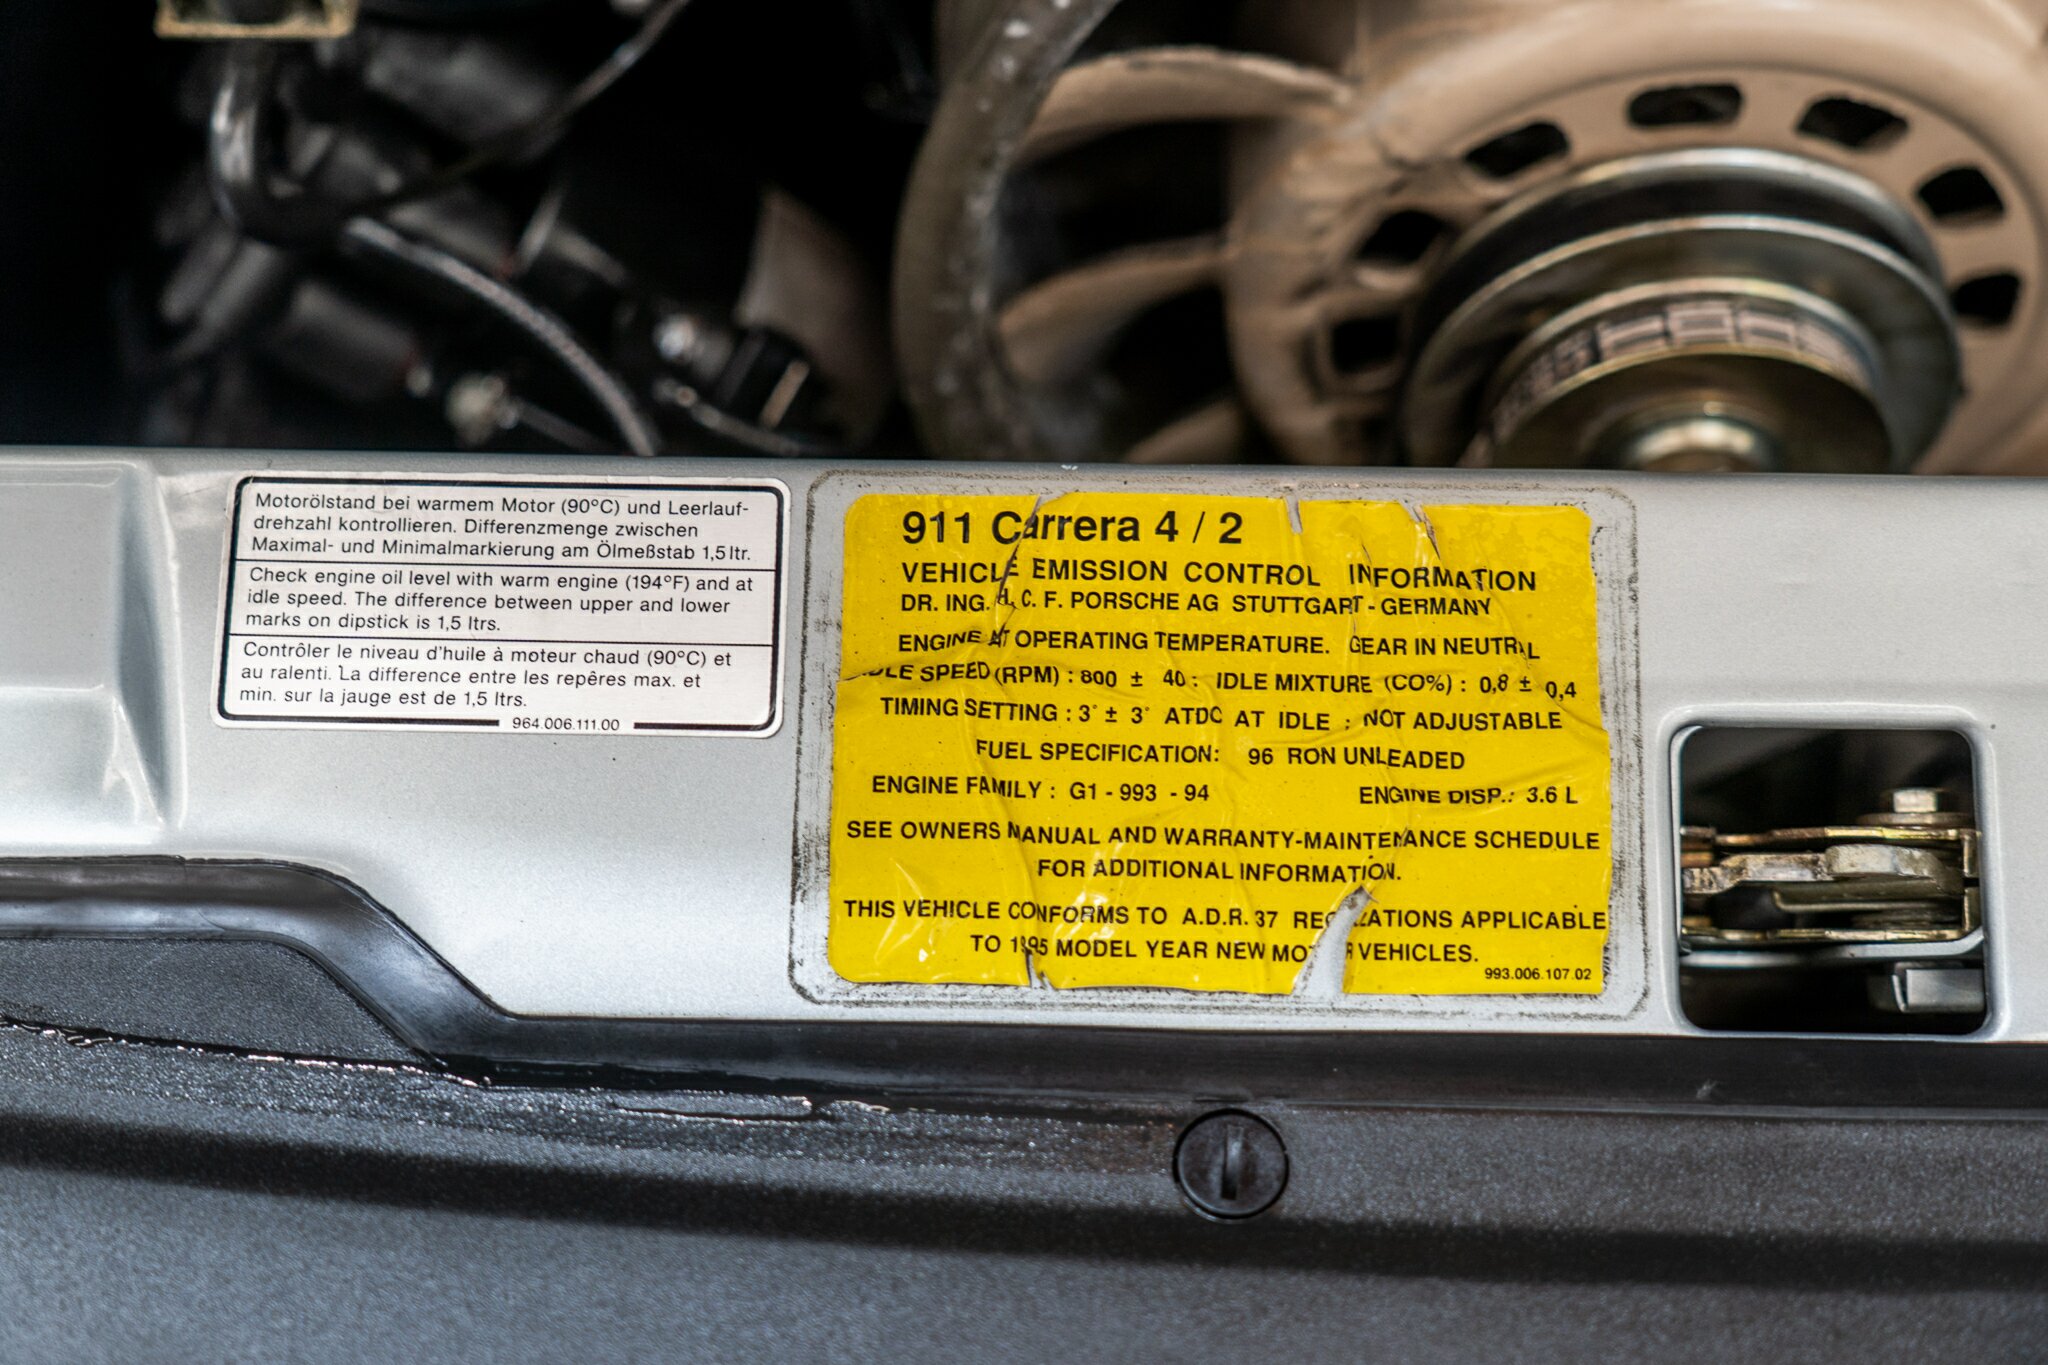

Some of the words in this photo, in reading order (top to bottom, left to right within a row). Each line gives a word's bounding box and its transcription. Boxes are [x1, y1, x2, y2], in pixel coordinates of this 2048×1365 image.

[256, 492, 376, 510] Motorölstand
[383, 495, 410, 511] bei
[417, 499, 494, 512] warmem
[501, 497, 556, 513] Motor
[627, 500, 661, 515] und
[668, 500, 749, 517] Leerlauf-
[253, 515, 332, 531] drehzahl
[338, 516, 458, 533] kontrollieren.
[464, 518, 608, 539] Differenzmenge
[615, 522, 698, 538] zwischen
[902, 510, 970, 545] 911
[991, 510, 1140, 545] Carrera
[1154, 510, 1179, 543] 4
[1218, 511, 1243, 545] 2
[252, 536, 334, 553] Maximal-
[341, 539, 375, 554] und
[382, 539, 555, 561] Minimalmarkierung
[561, 545, 589, 558] am
[596, 539, 695, 560] Ölmeßstab
[703, 545, 726, 561] 1,5
[729, 545, 752, 561] ltr.
[250, 566, 307, 583] Check
[314, 571, 376, 587] engine
[381, 570, 403, 585] oil
[409, 570, 451, 586] level
[456, 571, 493, 587] with
[500, 575, 550, 588] warm
[557, 576, 618, 592] engine
[695, 575, 729, 591] and
[735, 577, 753, 592] at
[901, 556, 1020, 584] VEHICLE
[1032, 557, 1168, 582] EMISSION
[1183, 561, 1321, 587] CONTROL
[1348, 563, 1536, 592] INFORMATION
[247, 589, 280, 604] idle
[287, 591, 348, 608] speed.
[354, 591, 388, 607] The
[394, 592, 487, 609] difference
[494, 594, 572, 610] between
[580, 599, 634, 615] upper
[639, 597, 674, 613] and
[680, 597, 731, 613] lower
[901, 593, 938, 612] DR.
[946, 593, 990, 613] ING.
[1021, 588, 1037, 608] C.
[1044, 590, 1063, 609] F.
[1070, 591, 1180, 611] PORSCHE
[1186, 593, 1219, 612] AG
[1232, 594, 1364, 615] STUTTGART
[1380, 597, 1491, 616] GERMANY
[246, 612, 301, 627] marks
[308, 615, 331, 628] on
[338, 613, 409, 632] dipstick
[416, 618, 430, 630] is
[438, 615, 462, 632] 1,5
[468, 615, 501, 631] ltrs.
[243, 641, 331, 658] Contrôler
[337, 643, 353, 659] le
[360, 647, 419, 660] niveau
[426, 645, 486, 662] d'huile
[493, 646, 503, 662] à
[511, 648, 577, 663] moteur
[583, 649, 640, 665] chaud
[713, 652, 732, 667] et
[898, 629, 982, 652] ENGINE
[987, 628, 1011, 648] AT
[1014, 629, 1149, 650] OPERATING
[1153, 631, 1330, 655] TEMPERATURE.
[1349, 634, 1408, 656] GEAR
[1414, 637, 1436, 656] IN
[241, 667, 263, 679] au
[270, 665, 333, 681] ralenti.
[338, 664, 361, 681] La
[368, 667, 461, 683] difference
[468, 670, 517, 685] entre
[524, 669, 549, 685] les
[556, 670, 626, 689] repêres
[634, 675, 677, 688] max.
[683, 674, 701, 688] et
[919, 661, 991, 683] SPEED
[993, 665, 1060, 687] (RPM)
[1080, 669, 1118, 688] 800
[1162, 669, 1186, 688] 40
[1216, 671, 1268, 691] IDLE
[1275, 673, 1373, 694] MIXTURE
[1383, 673, 1453, 696] (CO%)
[1479, 673, 1509, 694] 0,8
[1544, 680, 1577, 702] 0,4
[240, 689, 277, 701] min.
[284, 690, 313, 702] sur
[319, 688, 334, 703] la
[340, 692, 391, 707] jauge
[398, 691, 426, 705] est
[433, 690, 456, 706] de
[464, 691, 488, 707] 1,5
[495, 691, 527, 707] ltrs.
[512, 716, 620, 731] 964.006.111.00
[879, 696, 959, 717] TIMING
[963, 697, 1058, 722] SETTING
[1164, 705, 1223, 725] ATDC
[1234, 710, 1265, 728] AT
[1278, 711, 1330, 731] IDLE
[1362, 708, 1406, 730] NOT
[1412, 711, 1563, 732] ADJUSTABLE
[976, 738, 1033, 760] FUEL
[1248, 747, 1274, 766] 96
[1287, 746, 1336, 766] RON
[1343, 746, 1465, 770] UNLEADED
[872, 775, 959, 795] ENGINE
[966, 775, 1042, 799] FAMILY
[1069, 781, 1096, 801] G1
[1119, 783, 1157, 802] 993
[1184, 783, 1210, 802] 94
[1359, 785, 1441, 805] ENGINE
[1526, 785, 1558, 804] 3.6
[1565, 786, 1578, 805] L
[847, 820, 893, 839] SEE
[900, 820, 1001, 840] OWNERS
[1007, 820, 1101, 845] MANUAL
[1108, 825, 1157, 844] AND
[1164, 827, 1467, 850] WARRANTY-MAINTENANCE
[1474, 830, 1600, 850] SCHEDULE
[1037, 858, 1086, 878] FOR
[1092, 858, 1234, 880] ADDITIONAL
[1240, 862, 1401, 884] INFORMATION.
[843, 899, 896, 919] THIS
[903, 899, 1000, 920] VEHICLE
[1007, 901, 1130, 925] CONFORMS
[1136, 906, 1168, 925] TO
[1182, 907, 1249, 926] A.D.R.
[1254, 910, 1279, 929] 37
[1460, 910, 1606, 930] APPLICABLE
[969, 934, 1001, 953] TO
[1056, 938, 1137, 958] MODEL
[1146, 940, 1208, 959] YEAR
[1216, 941, 1266, 960] NEW
[1358, 942, 1479, 963] VEHICLES.
[1484, 967, 1592, 981] 993.006.107.02
